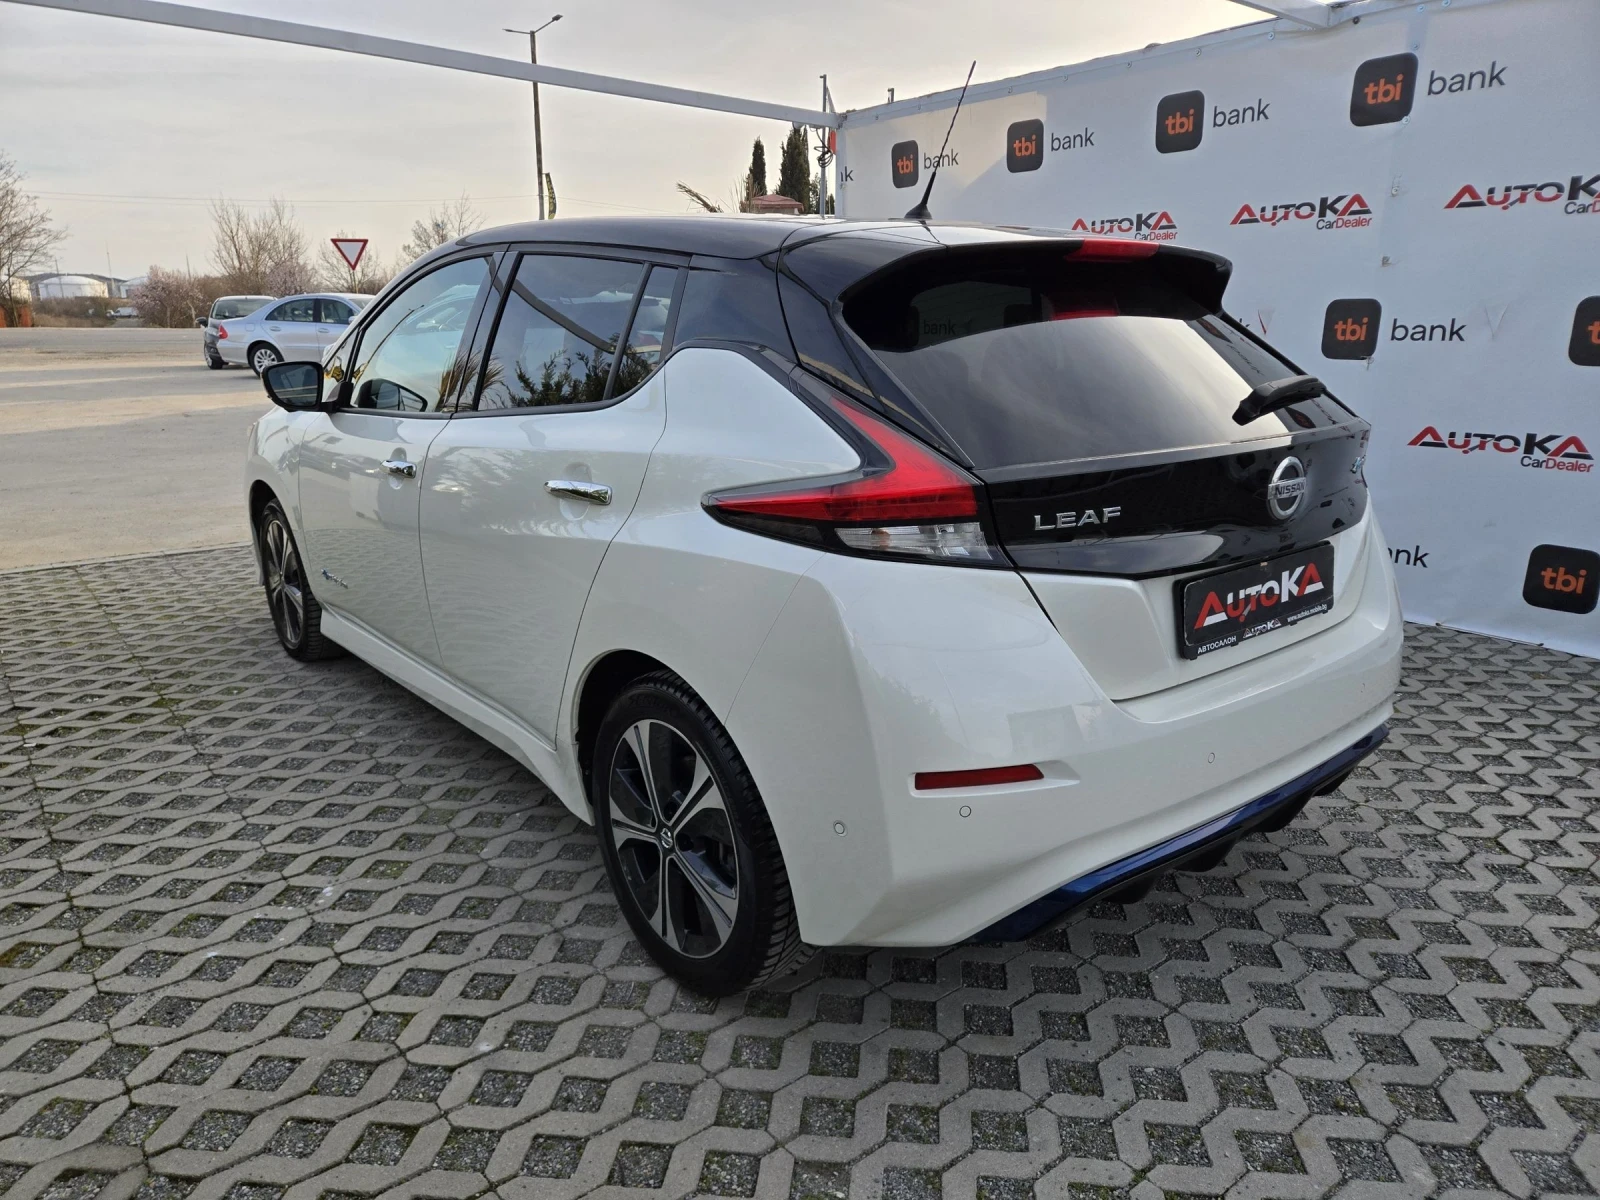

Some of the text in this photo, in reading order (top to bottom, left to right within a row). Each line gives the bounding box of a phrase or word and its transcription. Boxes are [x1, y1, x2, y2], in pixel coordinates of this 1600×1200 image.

[1364, 61, 1507, 105] tbi bank
[1165, 98, 1270, 136] tbi bank
[1013, 127, 1095, 157] tbi bank
[896, 148, 959, 174] tbi bank
[1443, 174, 1600, 210] AUTOK
[1230, 193, 1373, 227] AUTOKA
[1134, 230, 1178, 241] CarDealer
[1316, 215, 1373, 231] CarDealer
[923, 318, 957, 336] bank
[1334, 317, 1467, 342] tbi bank
[1407, 425, 1595, 461] AUTOKA
[1520, 455, 1595, 474] CarDealer
[1274, 480, 1305, 497] NISSAN
[1034, 506, 1122, 531] LEAF
[1388, 545, 1429, 568] nk
[1540, 566, 1588, 594] tbi
[1194, 562, 1325, 631] AUTOKA
[1197, 635, 1237, 654] АВТОСАЛОН
